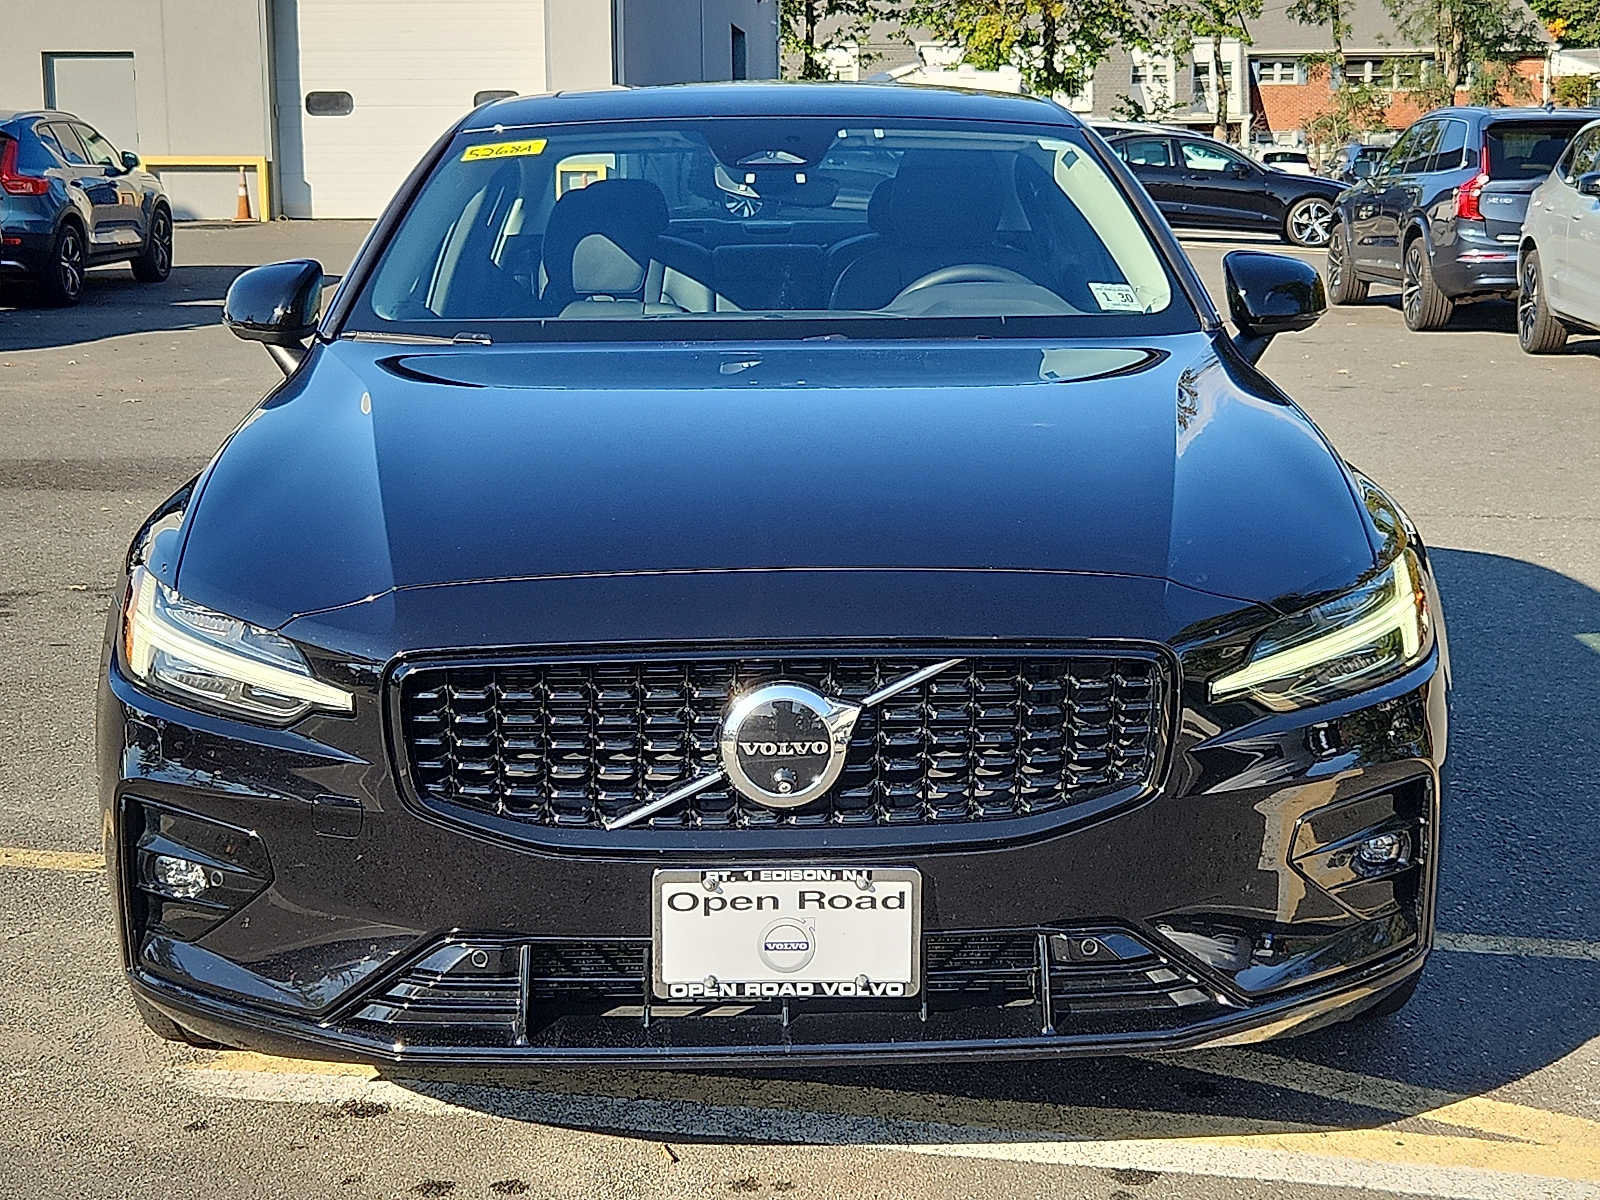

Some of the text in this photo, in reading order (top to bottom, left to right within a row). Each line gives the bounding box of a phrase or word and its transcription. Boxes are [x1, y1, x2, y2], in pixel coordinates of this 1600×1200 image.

[739, 741, 829, 756] VOLVO
[746, 870, 753, 881] 1
[667, 890, 905, 917] Open Road
[670, 983, 904, 997] OPEN ROAD VOLVO
